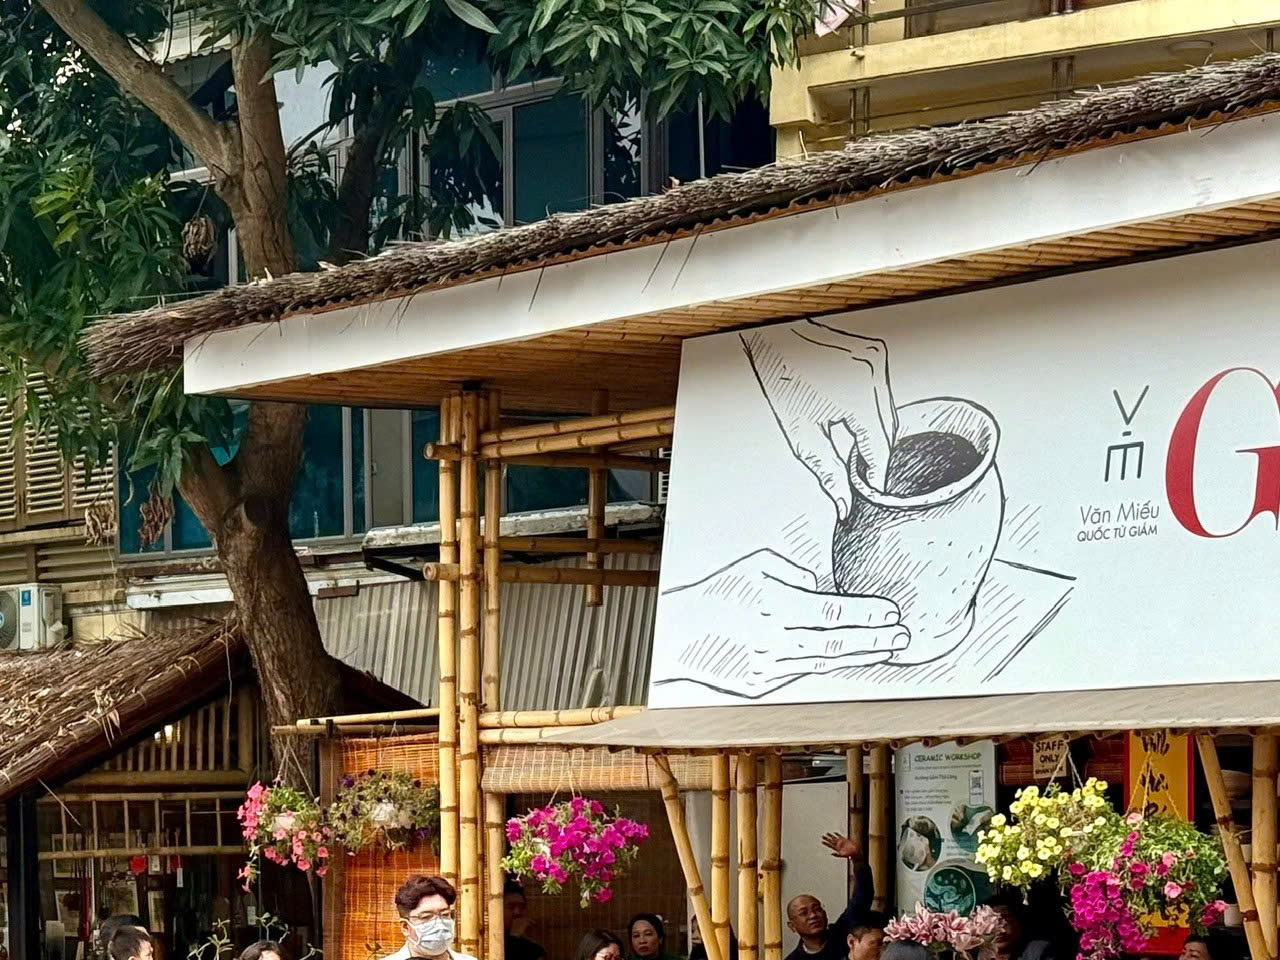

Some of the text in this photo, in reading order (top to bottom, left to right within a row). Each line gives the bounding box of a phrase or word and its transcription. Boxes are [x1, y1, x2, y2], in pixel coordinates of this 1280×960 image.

[1080, 500, 1159, 526] Văn Miếu
[1077, 525, 1111, 542] QUỐC
[1128, 522, 1158, 537] GIÁM
[1035, 739, 1064, 753] STAFF
[914, 752, 982, 762] CERAMIC WORKSHOP
[1039, 753, 1060, 764] ONLY
